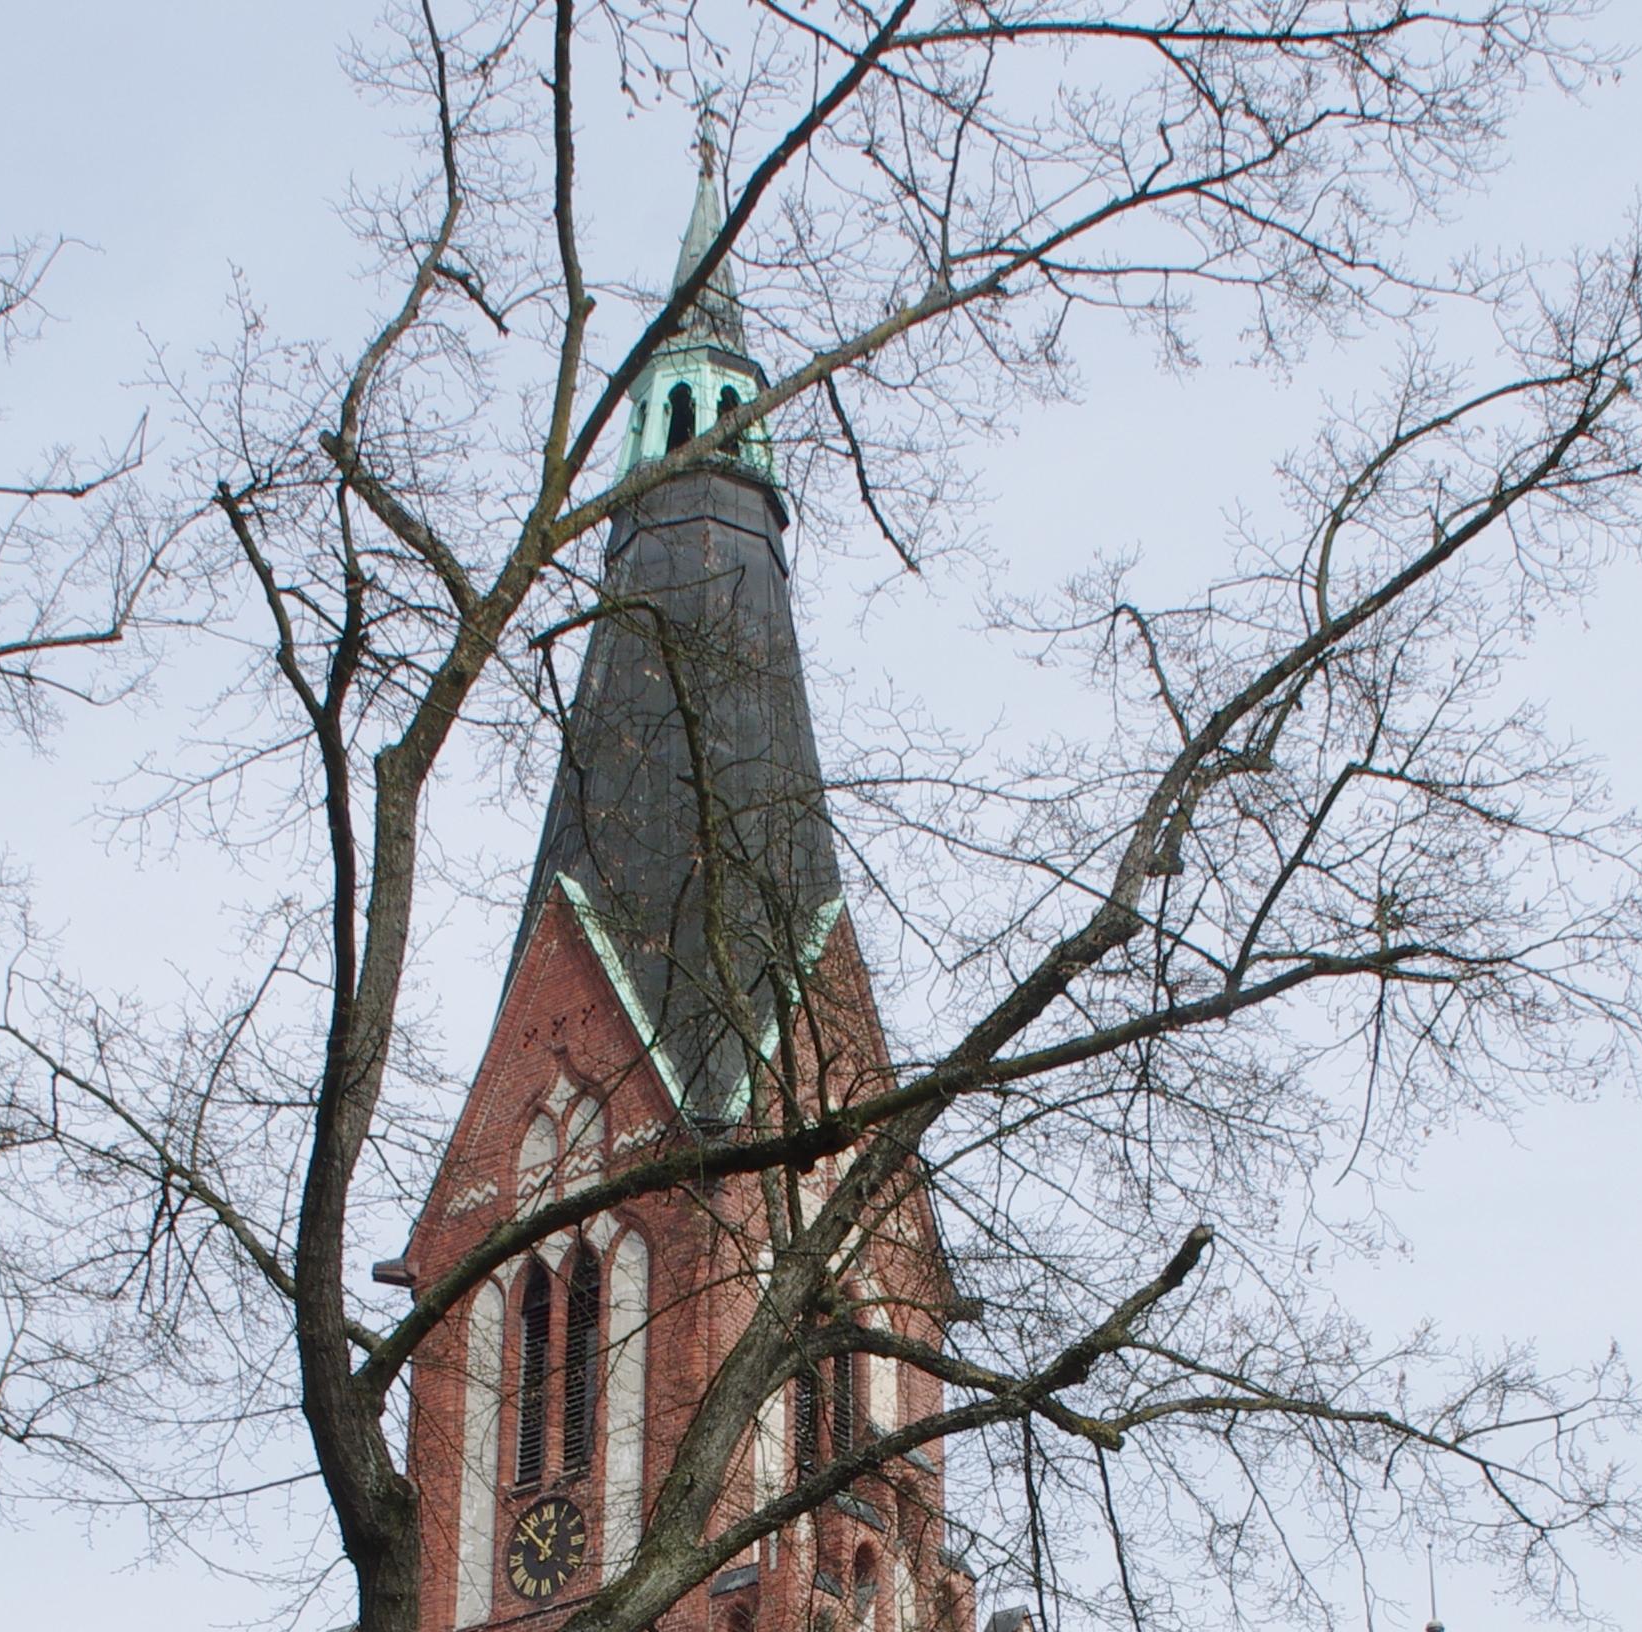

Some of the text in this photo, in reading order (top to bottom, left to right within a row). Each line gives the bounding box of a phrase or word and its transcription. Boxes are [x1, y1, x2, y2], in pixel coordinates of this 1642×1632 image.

[525, 1512, 541, 1529] XI
[541, 1504, 555, 1521] XII
[560, 1504, 568, 1521] I
[514, 1532, 529, 1545] X
[509, 1551, 523, 1568] IX
[557, 1570, 568, 1586] V
[541, 1577, 552, 1597] VI
